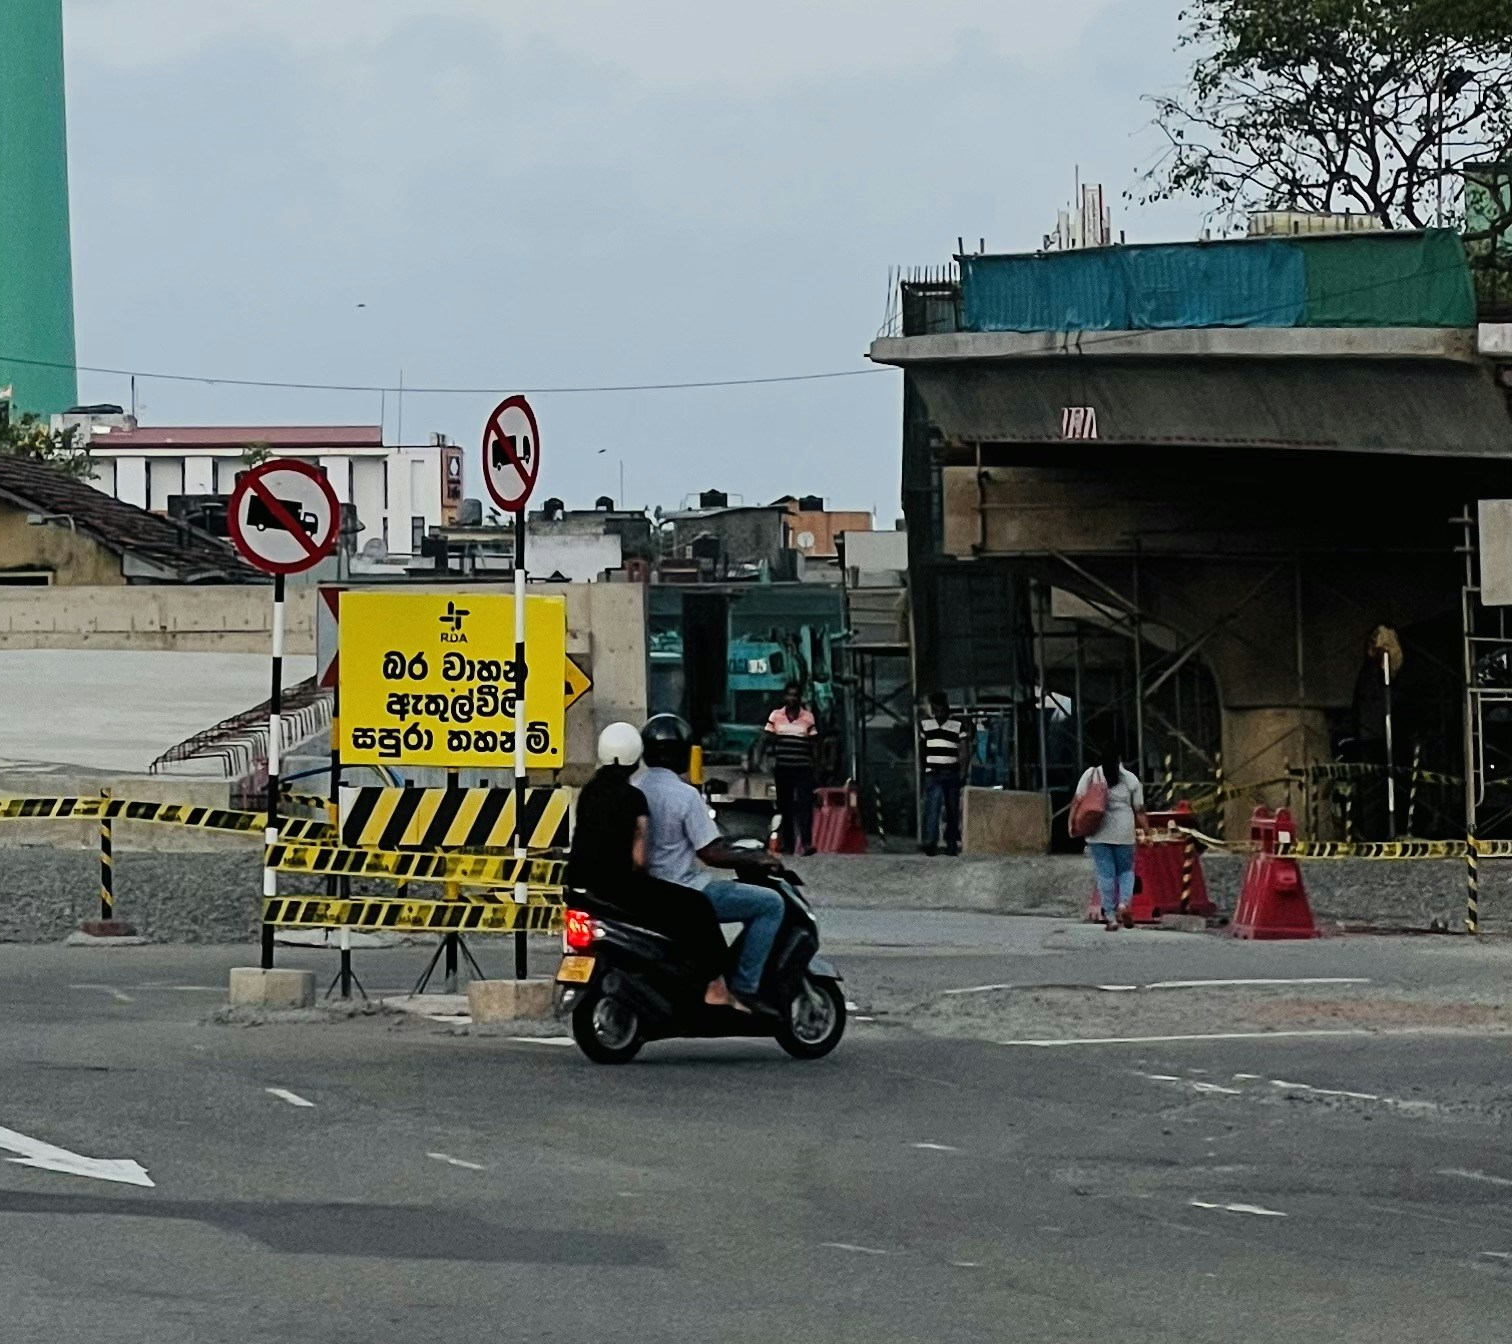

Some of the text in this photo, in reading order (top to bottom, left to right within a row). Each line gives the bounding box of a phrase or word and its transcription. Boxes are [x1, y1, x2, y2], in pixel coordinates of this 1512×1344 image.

[440, 632, 468, 643] RDA
[382, 651, 430, 680] බර
[352, 722, 434, 758] සපුරා
